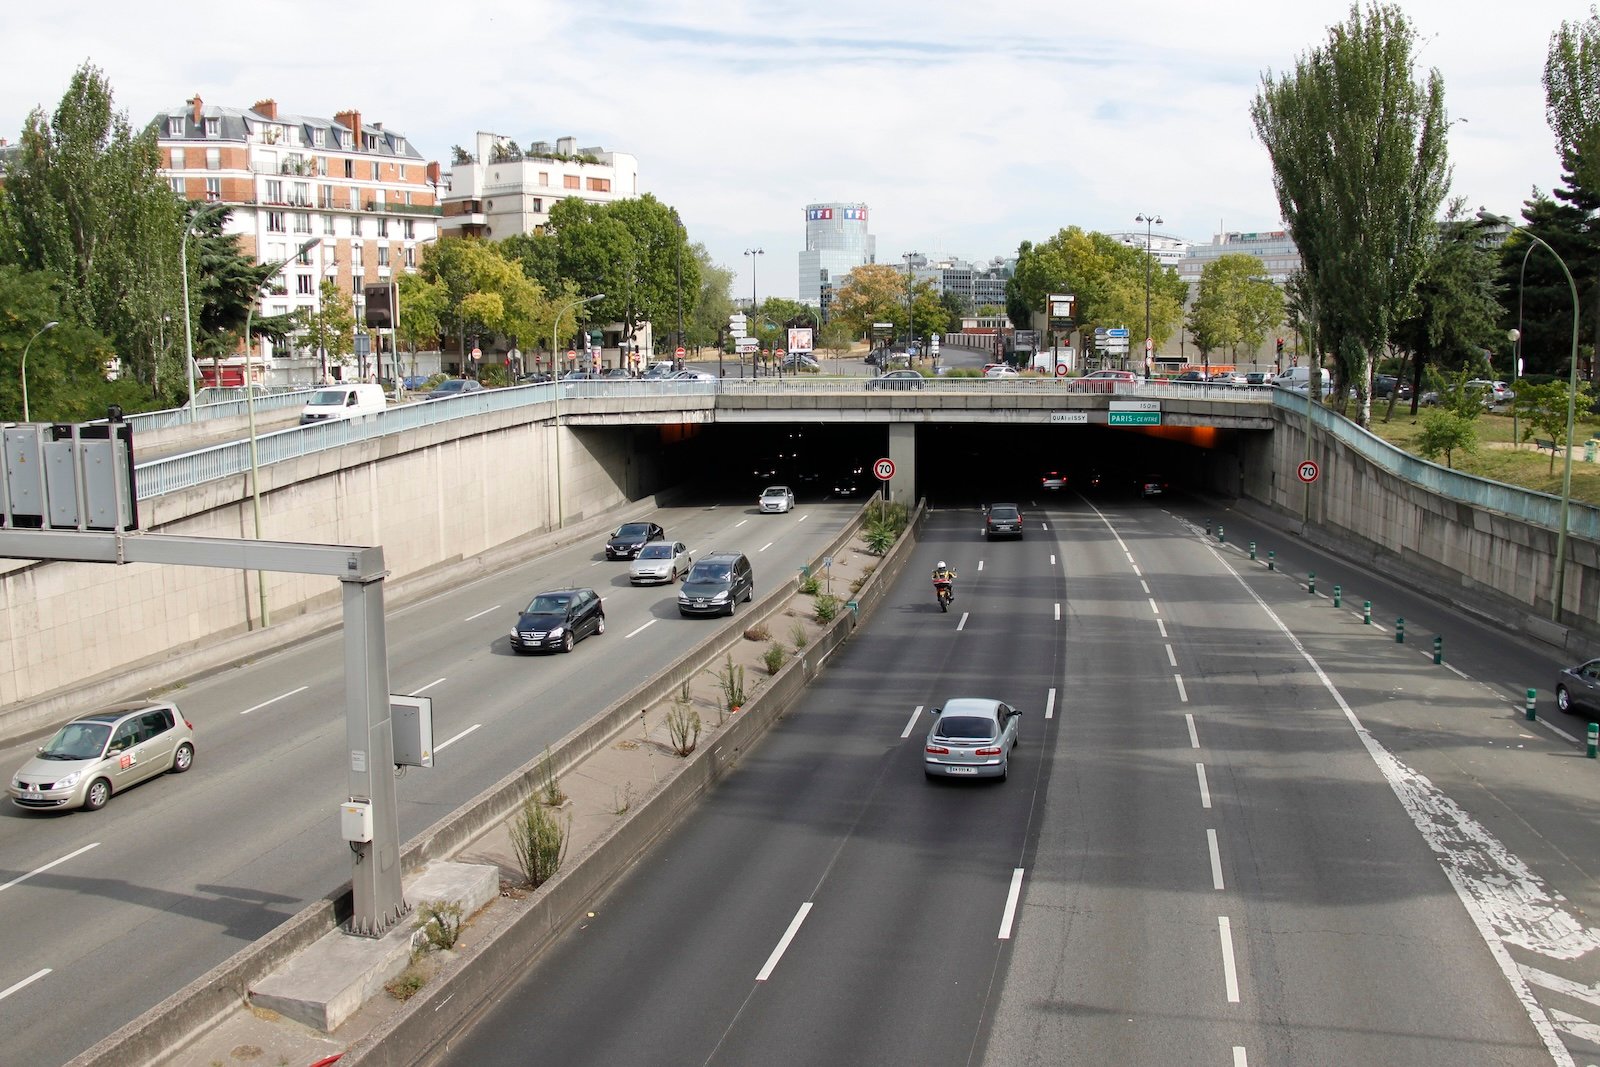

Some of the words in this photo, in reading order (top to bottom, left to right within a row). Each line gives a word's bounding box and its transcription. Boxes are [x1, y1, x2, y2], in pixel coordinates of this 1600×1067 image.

[810, 209, 830, 219] TF1
[846, 209, 865, 219] TF1
[879, 464, 891, 474] 70
[1302, 467, 1315, 476] 70
